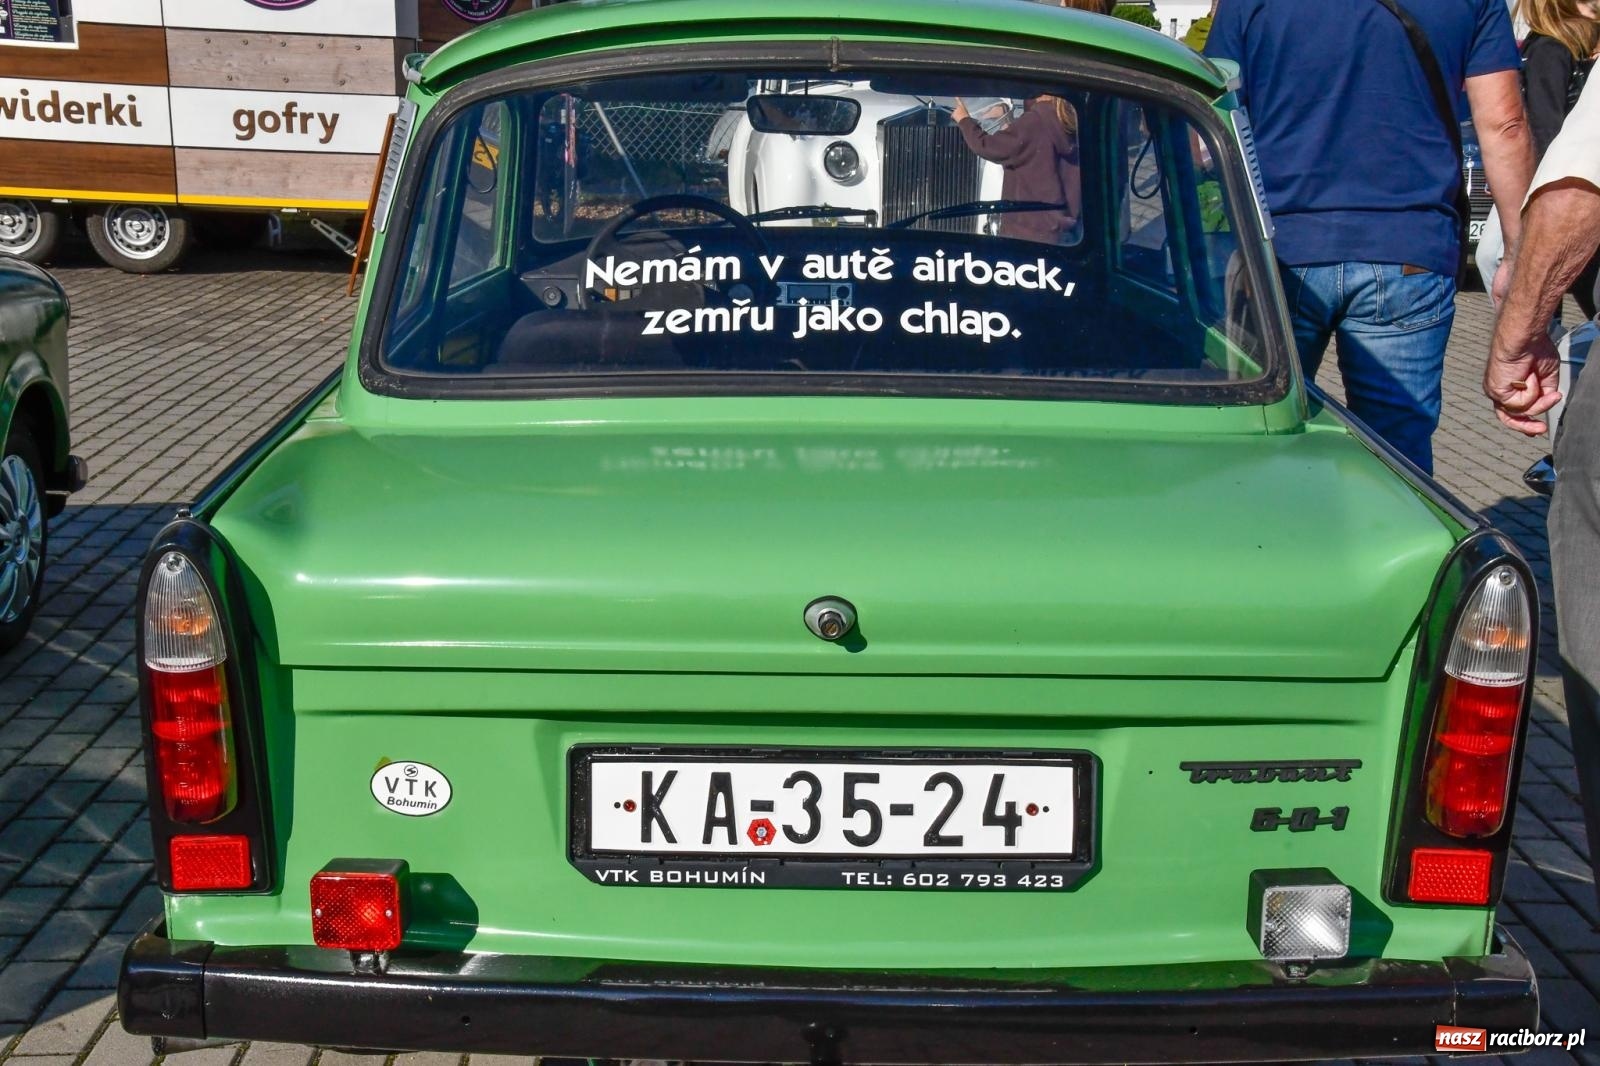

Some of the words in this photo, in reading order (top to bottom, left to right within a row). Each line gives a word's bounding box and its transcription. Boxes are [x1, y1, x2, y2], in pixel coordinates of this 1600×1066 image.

[232, 101, 340, 144] gofry
[585, 245, 741, 289] Nemám
[759, 255, 785, 280] v
[802, 247, 894, 281] autě
[912, 249, 1076, 297] airback,
[641, 298, 774, 335] zemřu
[792, 297, 883, 339] jako
[900, 301, 1022, 343] chlap.
[640, 770, 1022, 847] KA-35-24
[595, 869, 639, 883] VTK
[650, 866, 765, 884] BOHUMÍN
[841, 872, 893, 886] TEL:
[903, 873, 949, 887] 602
[960, 874, 1006, 887] 793
[1017, 874, 1063, 888] 423
